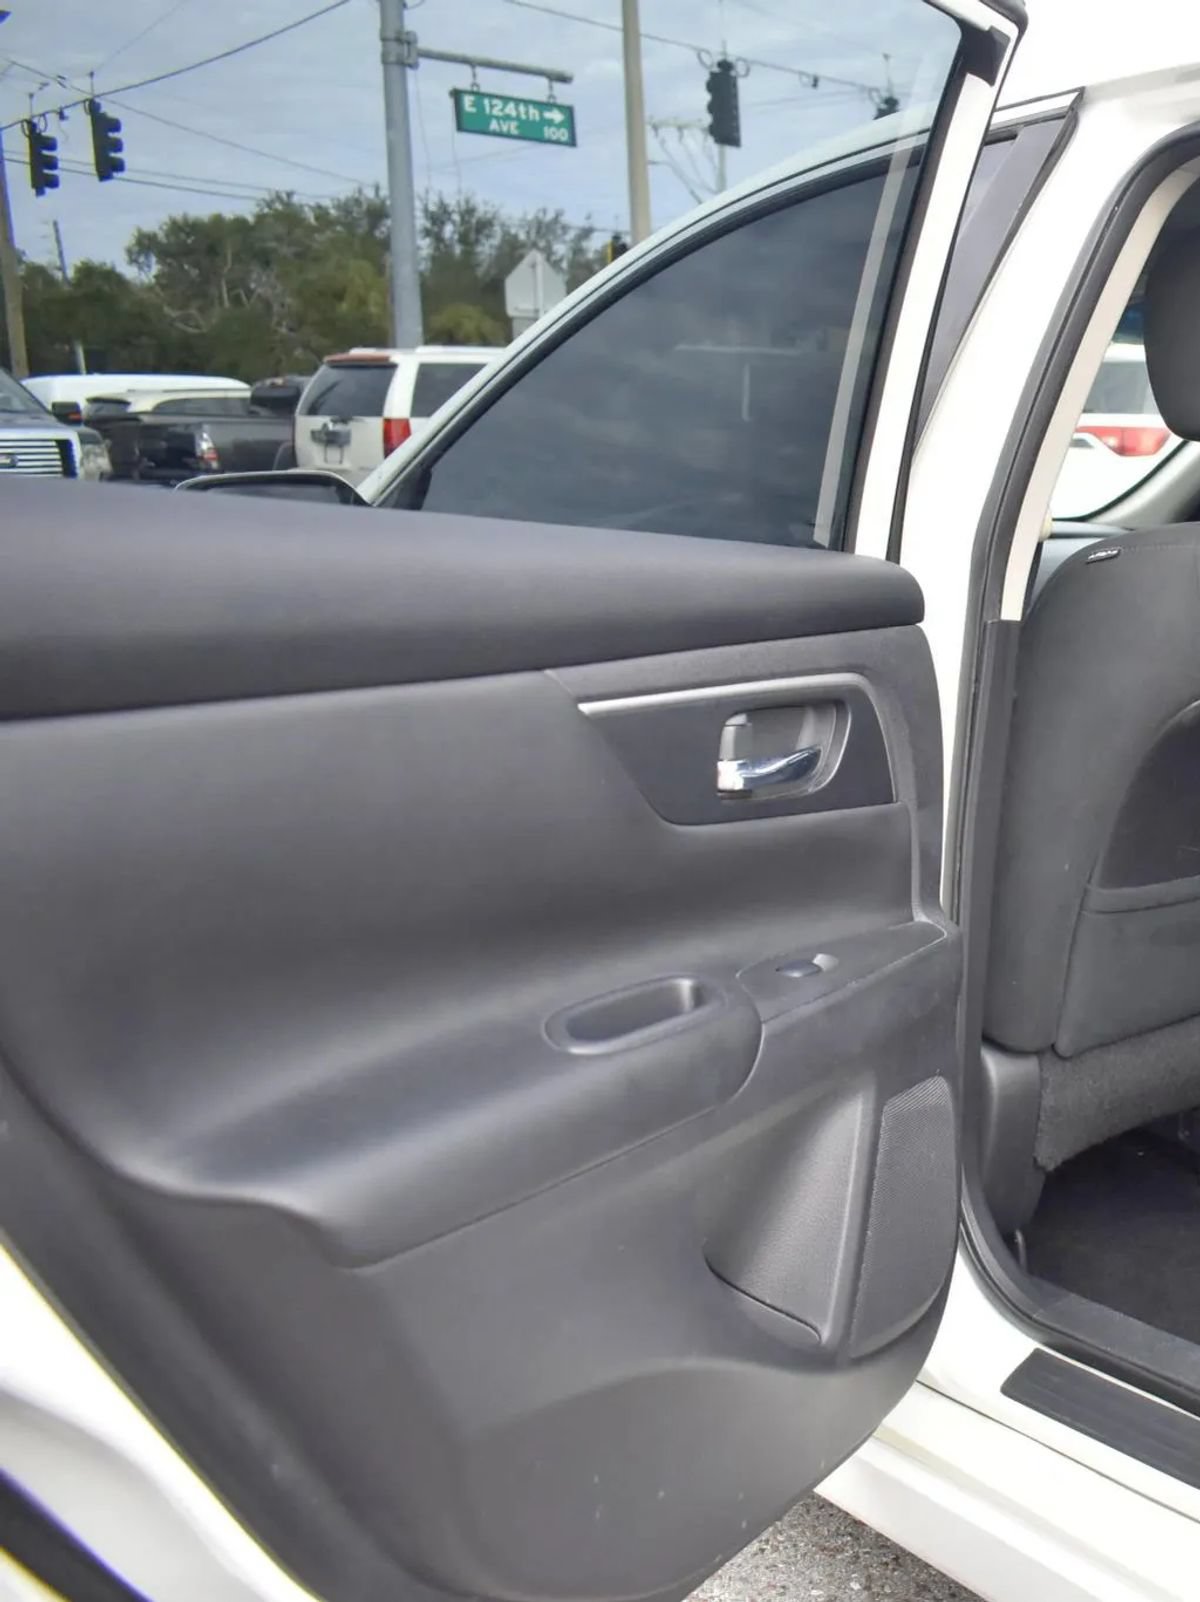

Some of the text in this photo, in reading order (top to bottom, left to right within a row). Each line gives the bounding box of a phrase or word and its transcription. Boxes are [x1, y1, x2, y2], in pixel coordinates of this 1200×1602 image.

[464, 94, 540, 121] E 124th
[489, 118, 519, 135] AVE
[543, 126, 569, 142] 100
